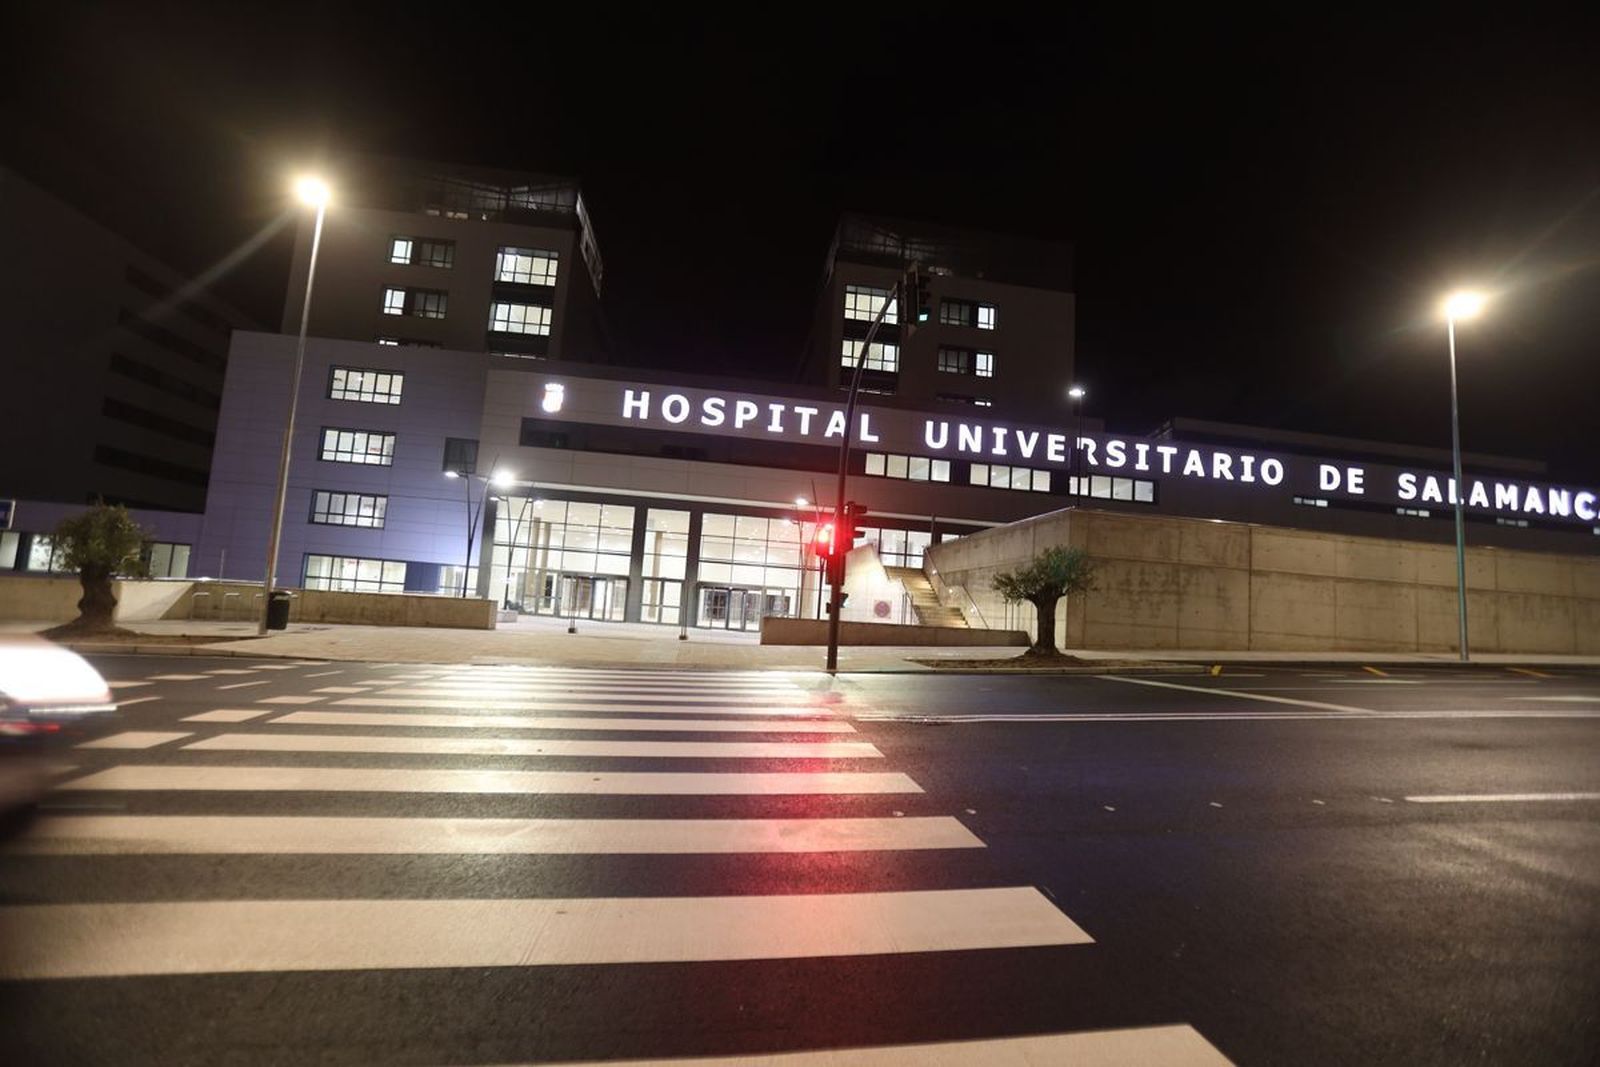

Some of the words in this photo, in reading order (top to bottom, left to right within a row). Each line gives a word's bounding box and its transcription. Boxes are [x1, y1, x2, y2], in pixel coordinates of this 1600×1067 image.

[622, 389, 880, 443] HOSPITAL
[924, 420, 1284, 487] UNIVERSITARIO
[1319, 464, 1365, 495] DE
[1396, 472, 1600, 521] SALAMANC
